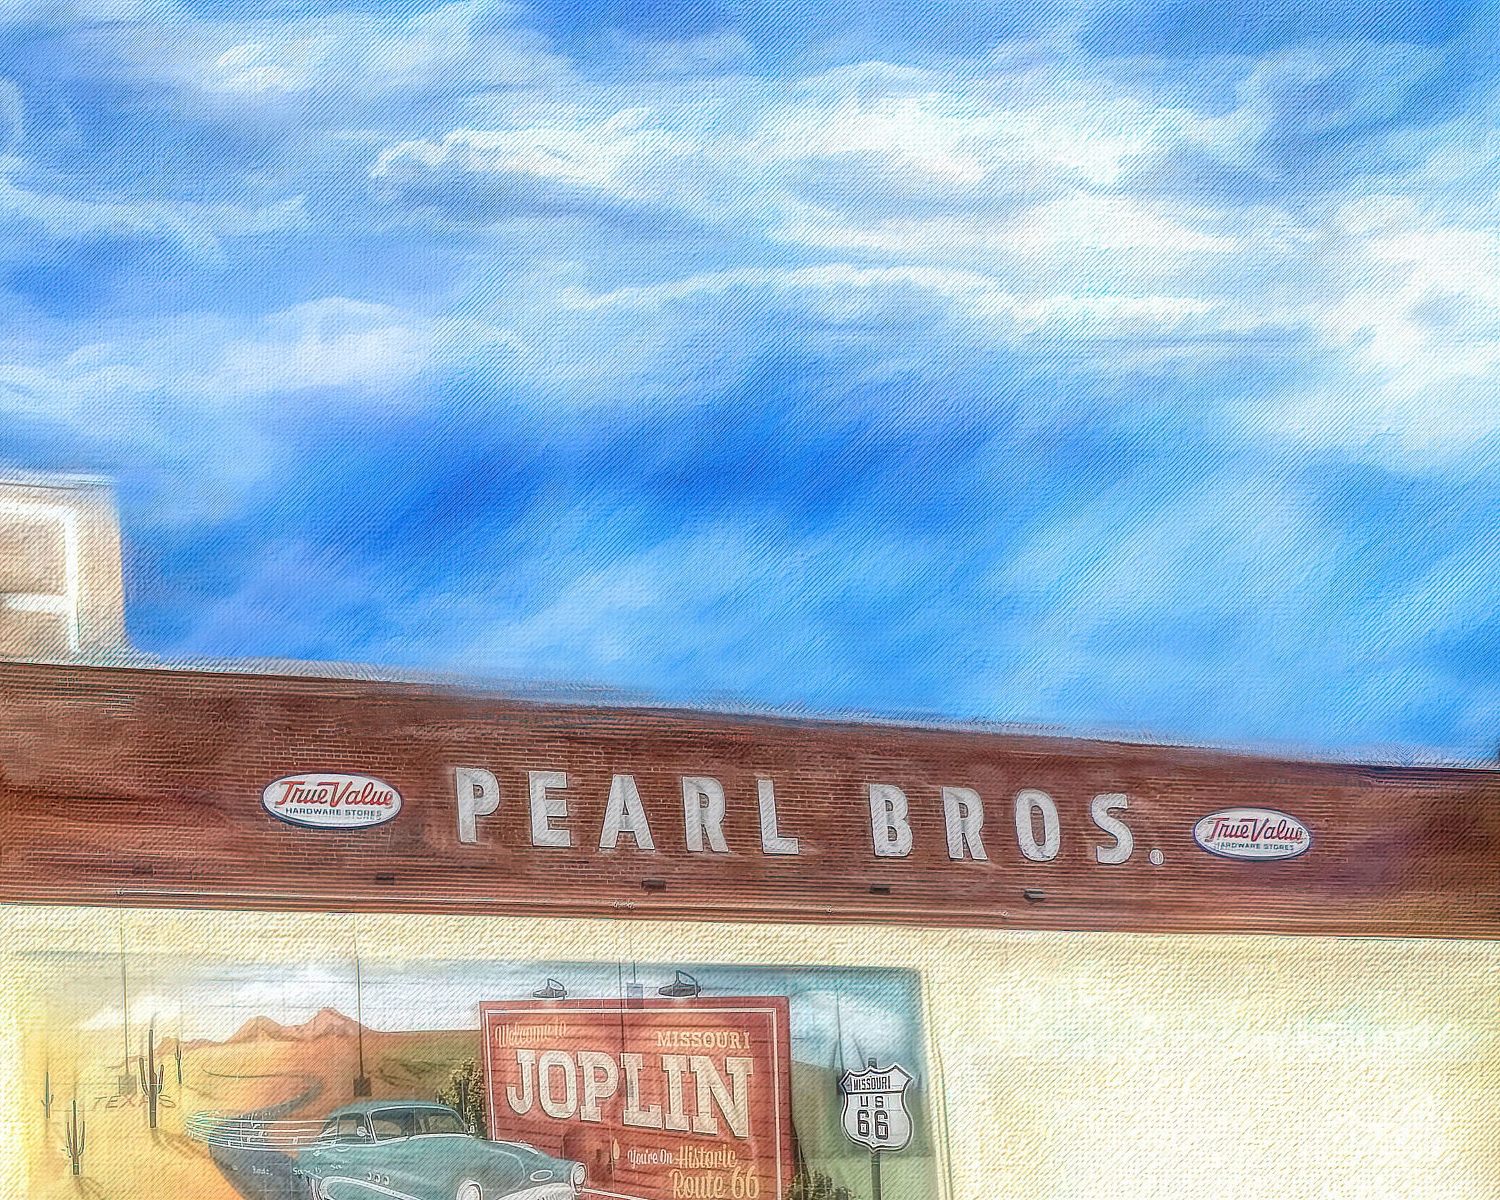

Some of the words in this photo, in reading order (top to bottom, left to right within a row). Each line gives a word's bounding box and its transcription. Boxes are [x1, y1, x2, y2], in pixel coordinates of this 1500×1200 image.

[286, 807, 341, 816] HARDWARE
[345, 809, 382, 818] STORES
[456, 767, 799, 855] PEARL
[869, 784, 1164, 865] BROS.
[1263, 843, 1294, 851] STORES
[657, 1031, 750, 1050] MISSOURI
[507, 1049, 754, 1138] JOPLIN
[851, 1075, 891, 1090] MISSOURI
[857, 1110, 888, 1140] 66
[627, 1148, 658, 1169] You're
[659, 1148, 673, 1164] On
[674, 1144, 738, 1169] Historic
[668, 1168, 726, 1199] Route
[731, 1165, 760, 1199] 66
